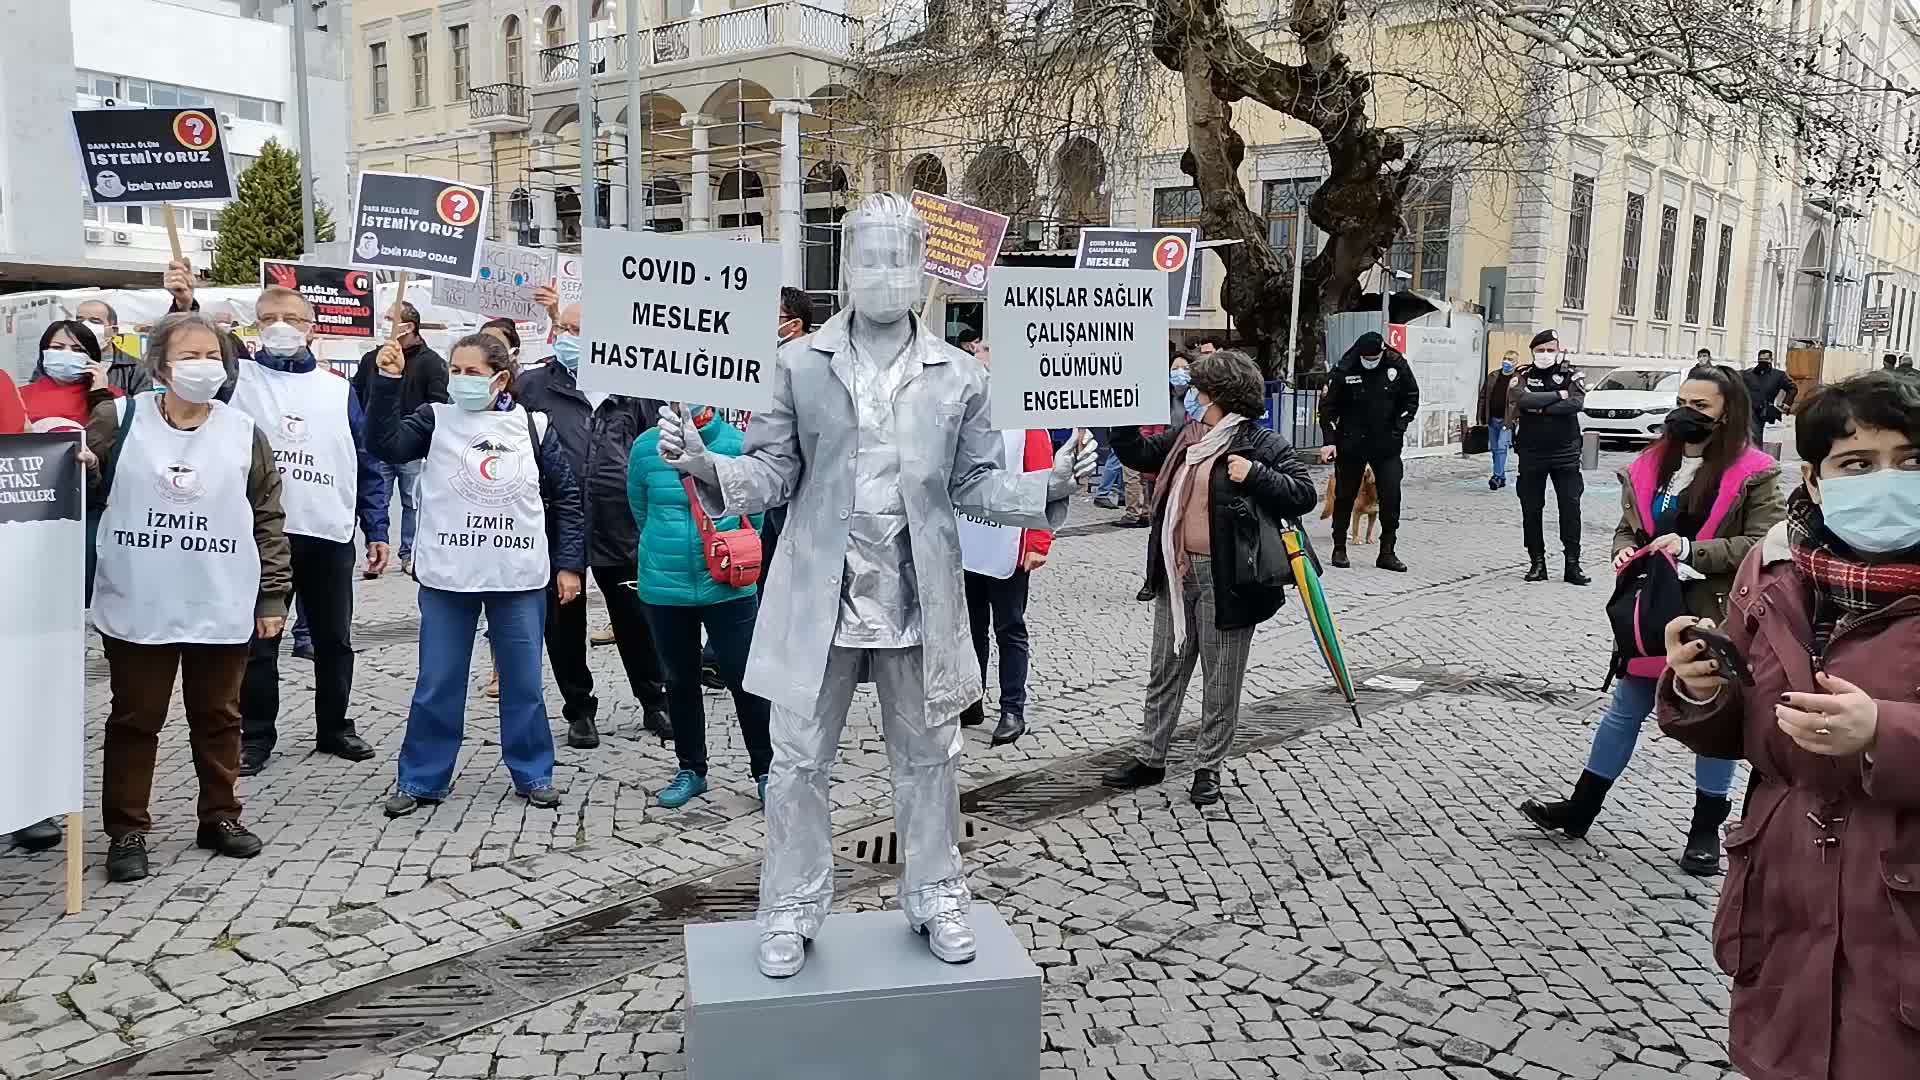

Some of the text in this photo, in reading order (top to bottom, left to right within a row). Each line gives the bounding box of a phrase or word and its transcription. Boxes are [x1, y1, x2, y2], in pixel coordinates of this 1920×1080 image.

[89, 150, 211, 166] İSTEMİYORUZ
[184, 180, 214, 189] ODASI
[361, 212, 465, 239] İSTEMİYORUZ
[428, 252, 458, 265] ODASI
[1086, 257, 1130, 267] MESLEK
[622, 255, 696, 286] COVID
[720, 265, 748, 291] 19
[1004, 283, 1153, 311] ALKIŞLAR SAĞLIK
[632, 301, 731, 335] MESLEK
[1026, 322, 1134, 348] ÇALIŞANININ
[590, 341, 761, 384] HASTALIĞIDIR
[1039, 352, 1123, 377] ÖLÜMÜNÜ
[1023, 384, 1139, 411] ENGELLEMEDİ
[272, 449, 314, 467] ZMİR
[292, 468, 334, 487] ODASI
[147, 507, 209, 532] İZMİR
[466, 512, 515, 531] İZMİR
[113, 529, 237, 554] TABİP ODASI
[438, 530, 535, 550] TABİP ODASI
